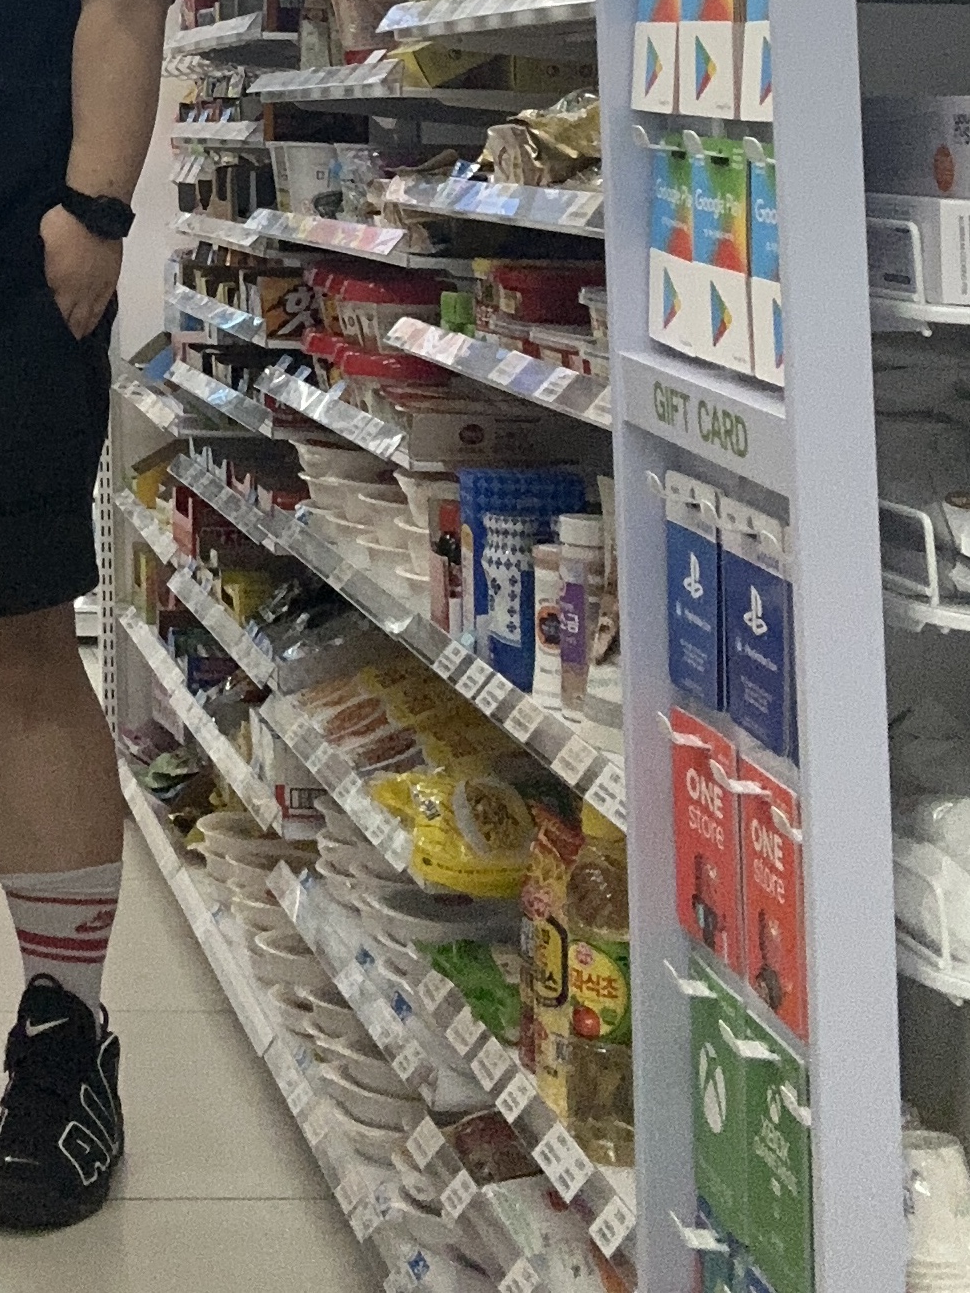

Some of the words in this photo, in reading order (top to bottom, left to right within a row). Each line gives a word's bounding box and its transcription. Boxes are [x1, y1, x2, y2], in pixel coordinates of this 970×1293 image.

[652, 380, 691, 434] GIFT
[697, 399, 749, 458] CARD
[686, 767, 723, 819] ONE
[687, 804, 725, 851] store
[751, 818, 785, 872] ONE
[753, 857, 786, 905] store
